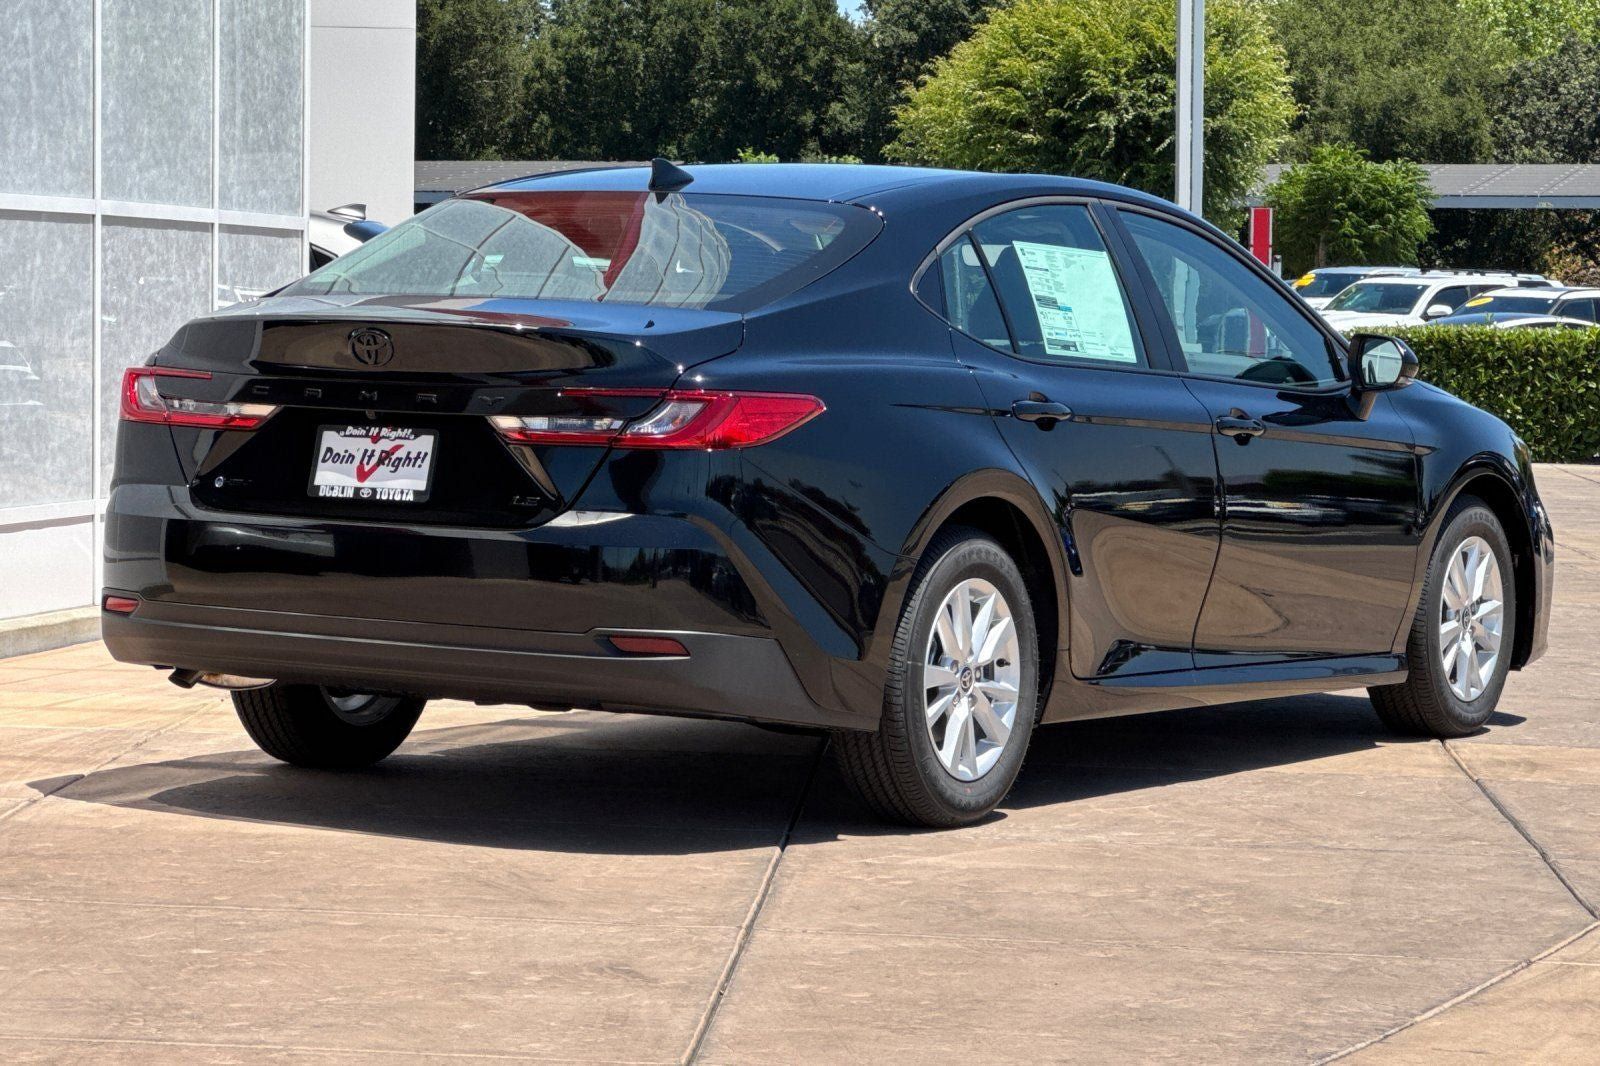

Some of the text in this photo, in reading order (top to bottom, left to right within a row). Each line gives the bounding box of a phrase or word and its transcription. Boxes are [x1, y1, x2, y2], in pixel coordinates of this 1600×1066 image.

[369, 427, 380, 437] It
[380, 427, 412, 440] Right!
[361, 448, 376, 466] It
[377, 450, 428, 474] Right!
[319, 485, 414, 502] DUBLIN TOYOTA
